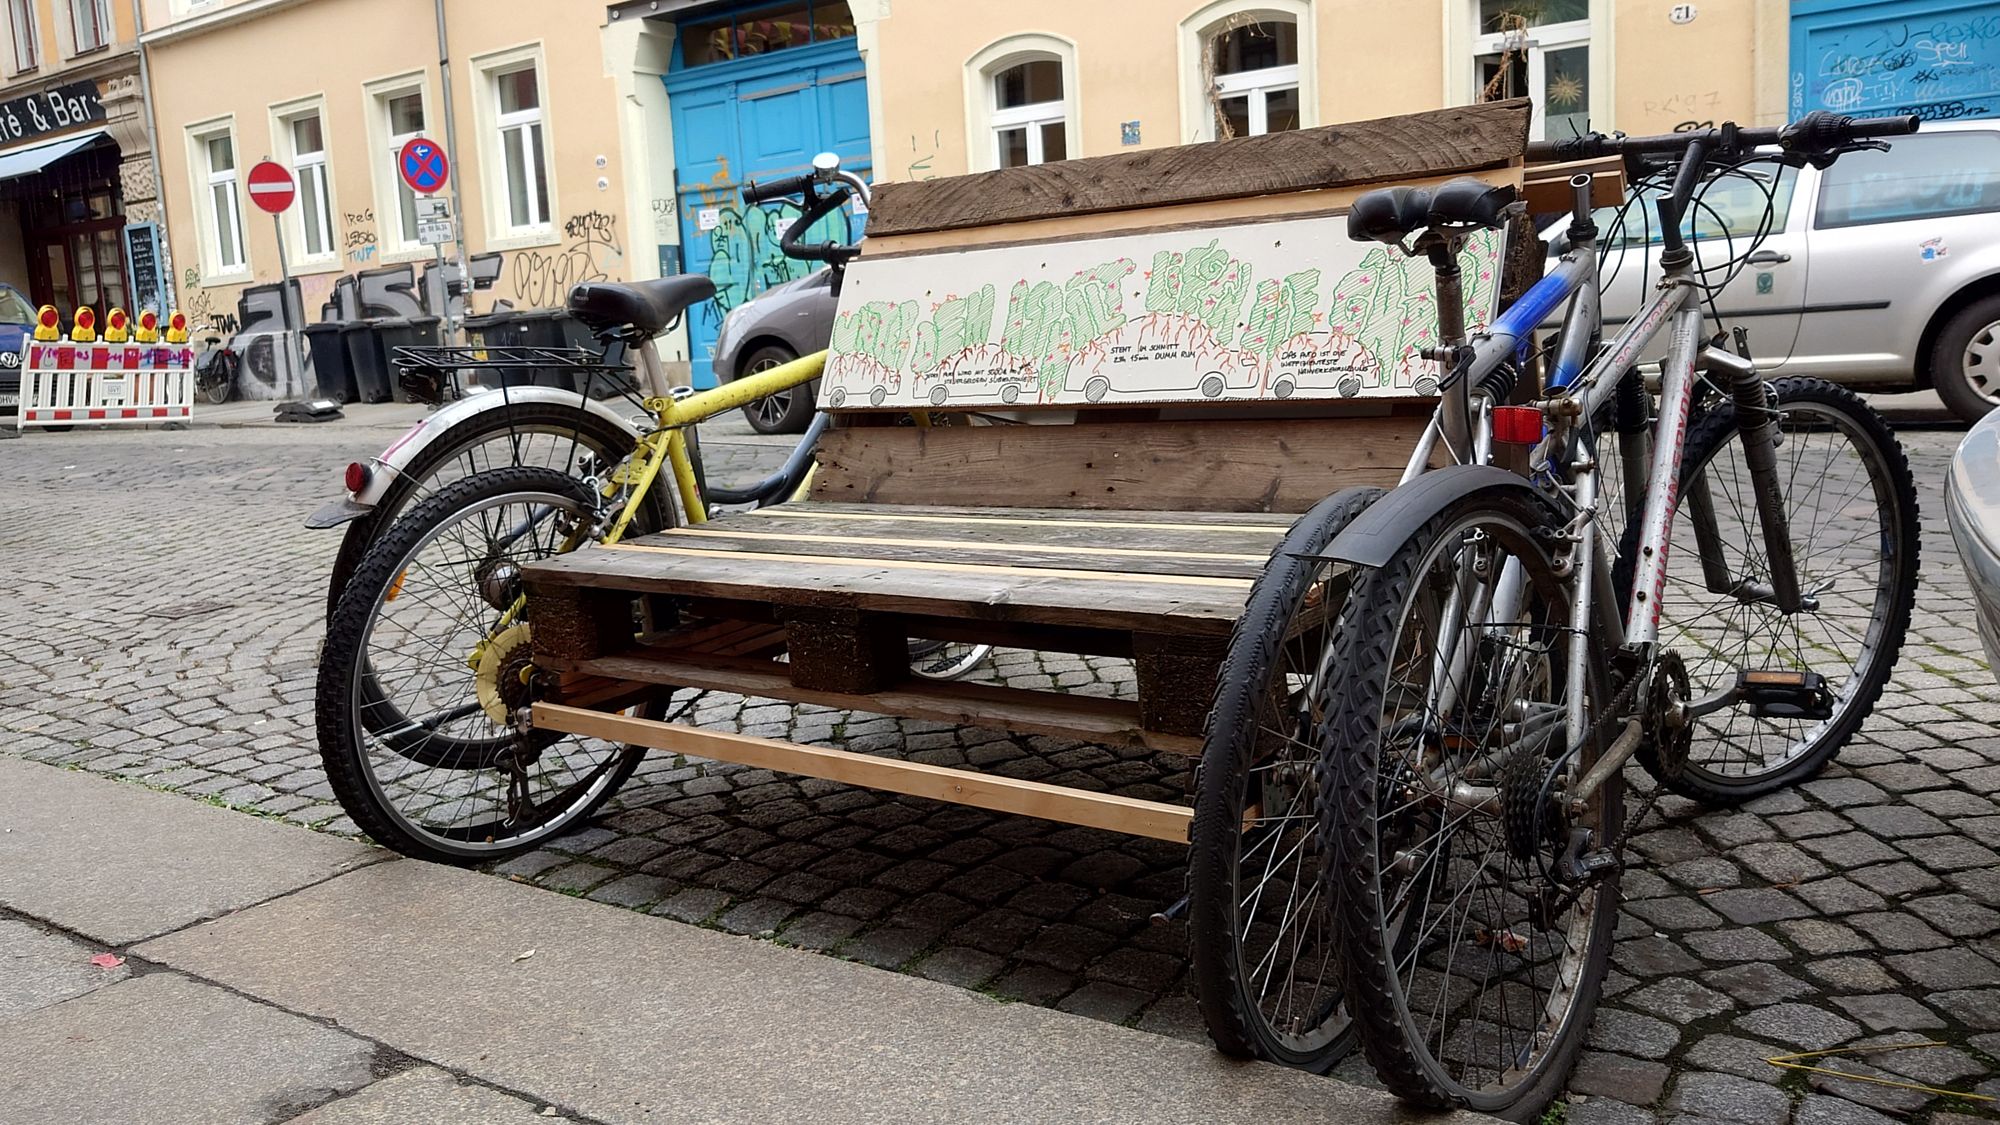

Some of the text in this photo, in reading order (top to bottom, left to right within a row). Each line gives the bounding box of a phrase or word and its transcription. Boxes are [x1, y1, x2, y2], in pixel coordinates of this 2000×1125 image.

[1674, 6, 1690, 19] 71
[26, 98, 52, 132] &
[47, 91, 92, 127] Bar
[833, 299, 920, 372] UNTER
[1154, 351, 1177, 360] DUMM
[1180, 350, 1196, 359] RUM
[1281, 350, 1297, 360] DAS
